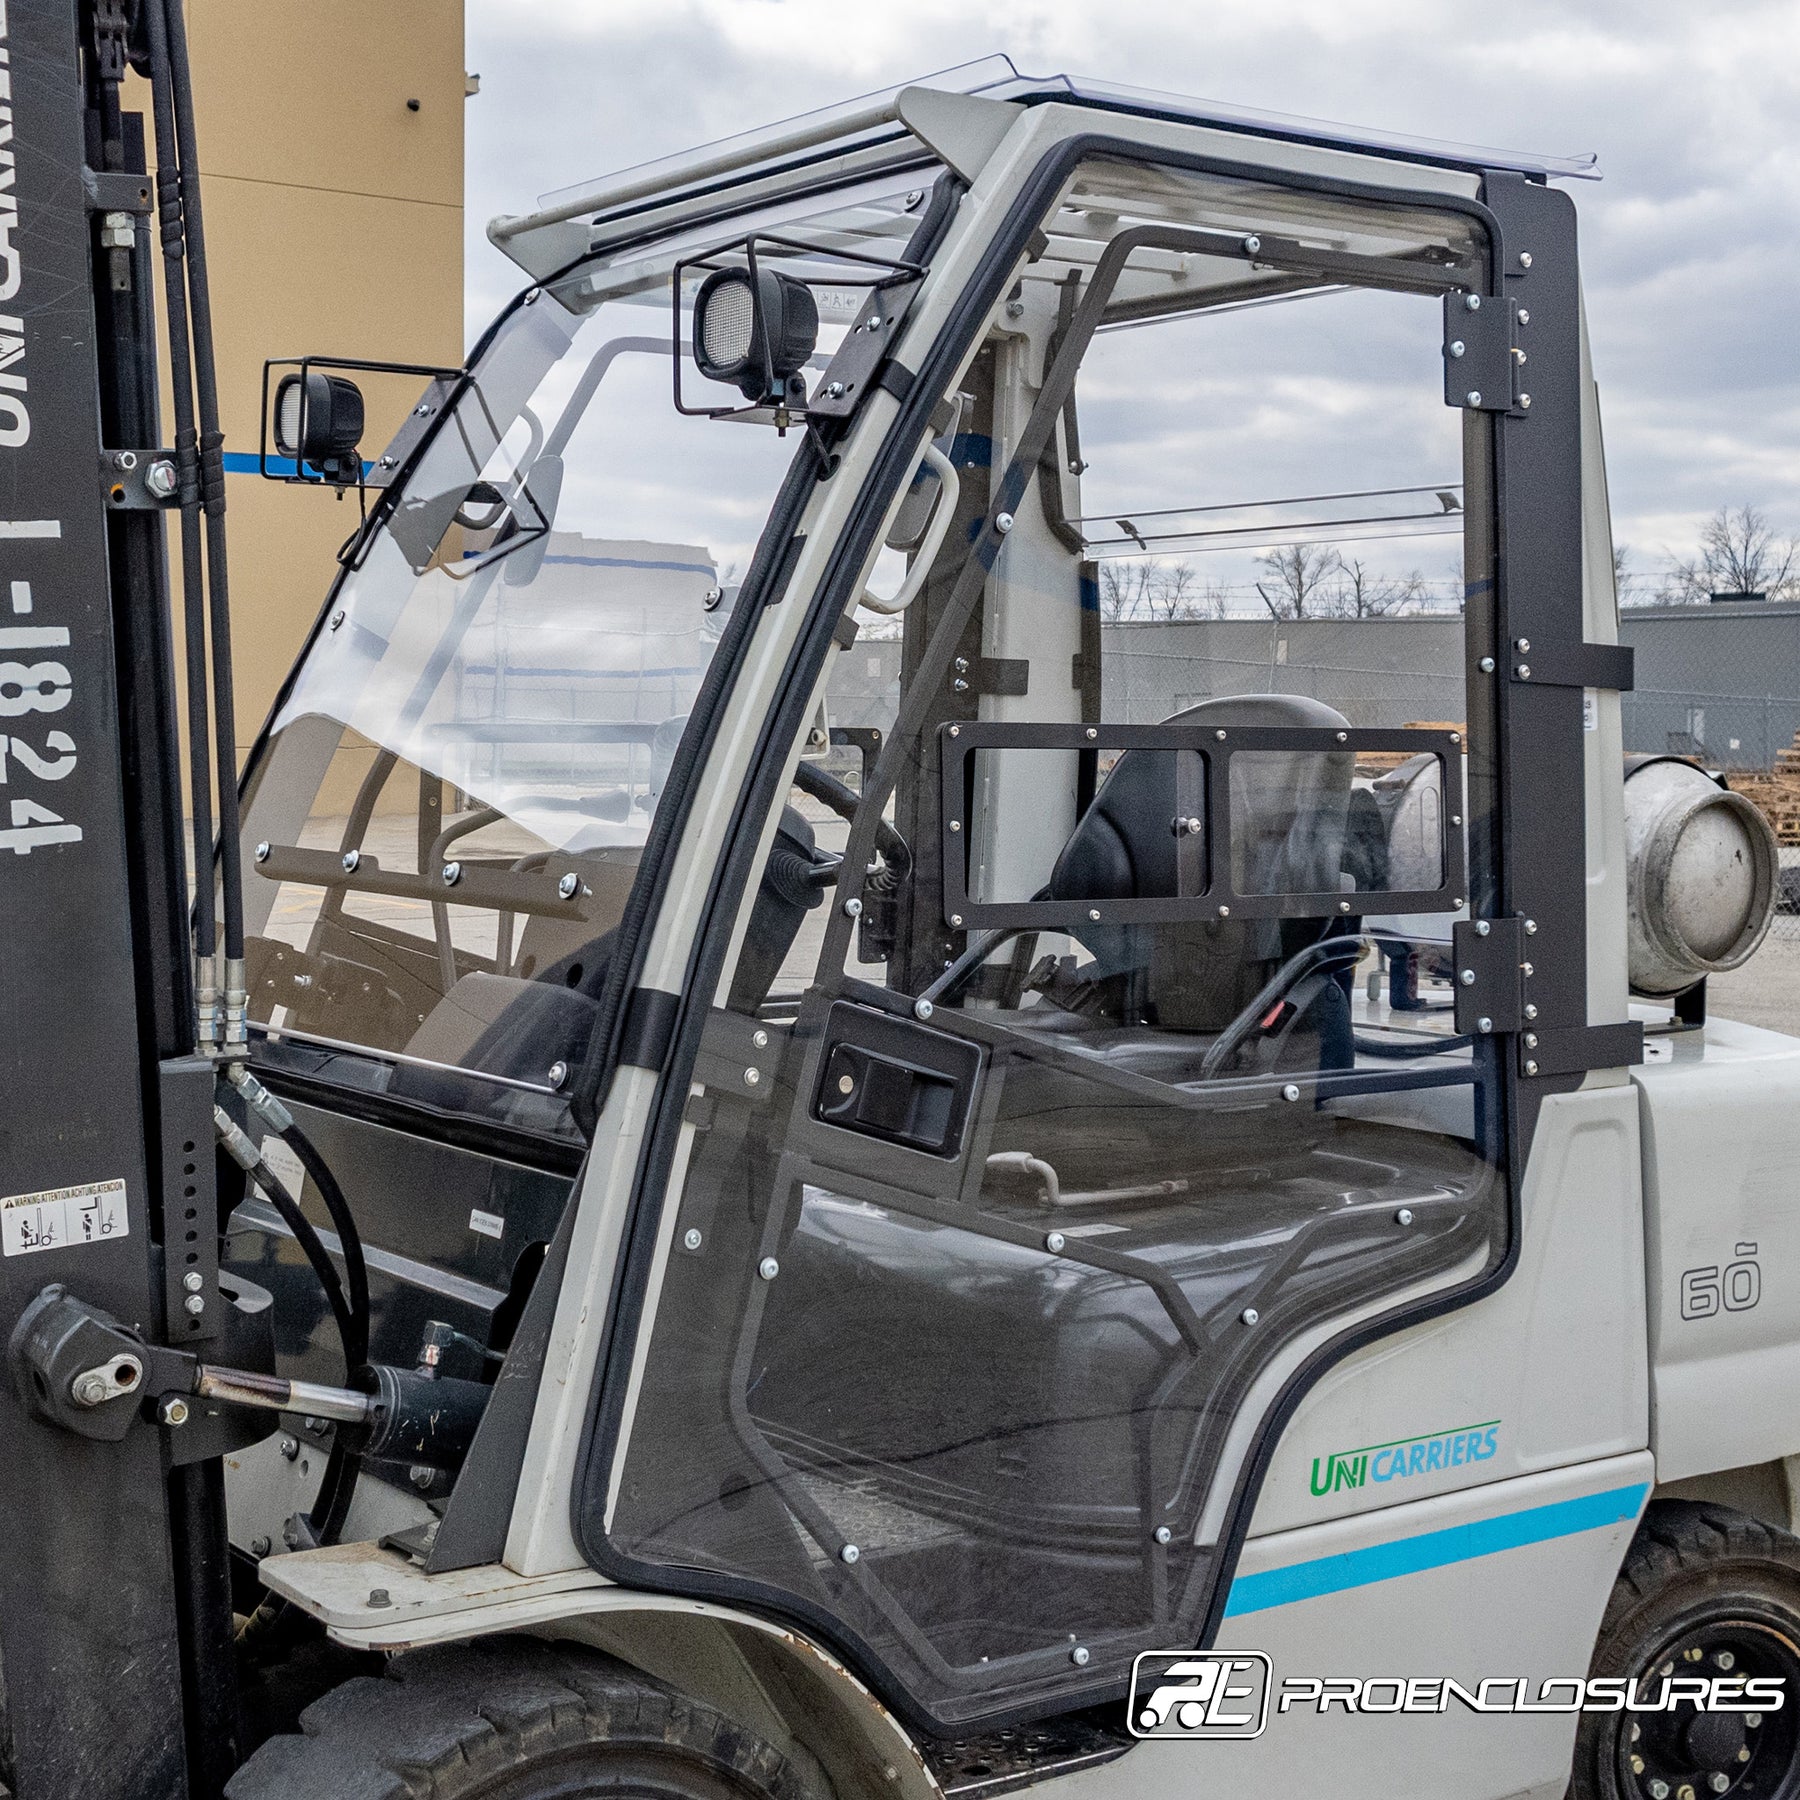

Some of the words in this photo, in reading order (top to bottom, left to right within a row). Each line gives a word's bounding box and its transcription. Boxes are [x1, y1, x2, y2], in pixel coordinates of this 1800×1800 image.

[15, 1194, 40, 1208] WARNING
[42, 1189, 70, 1203] ATTENTION
[70, 1184, 97, 1199] ACHTUNG
[1681, 1260, 1761, 1321] 60
